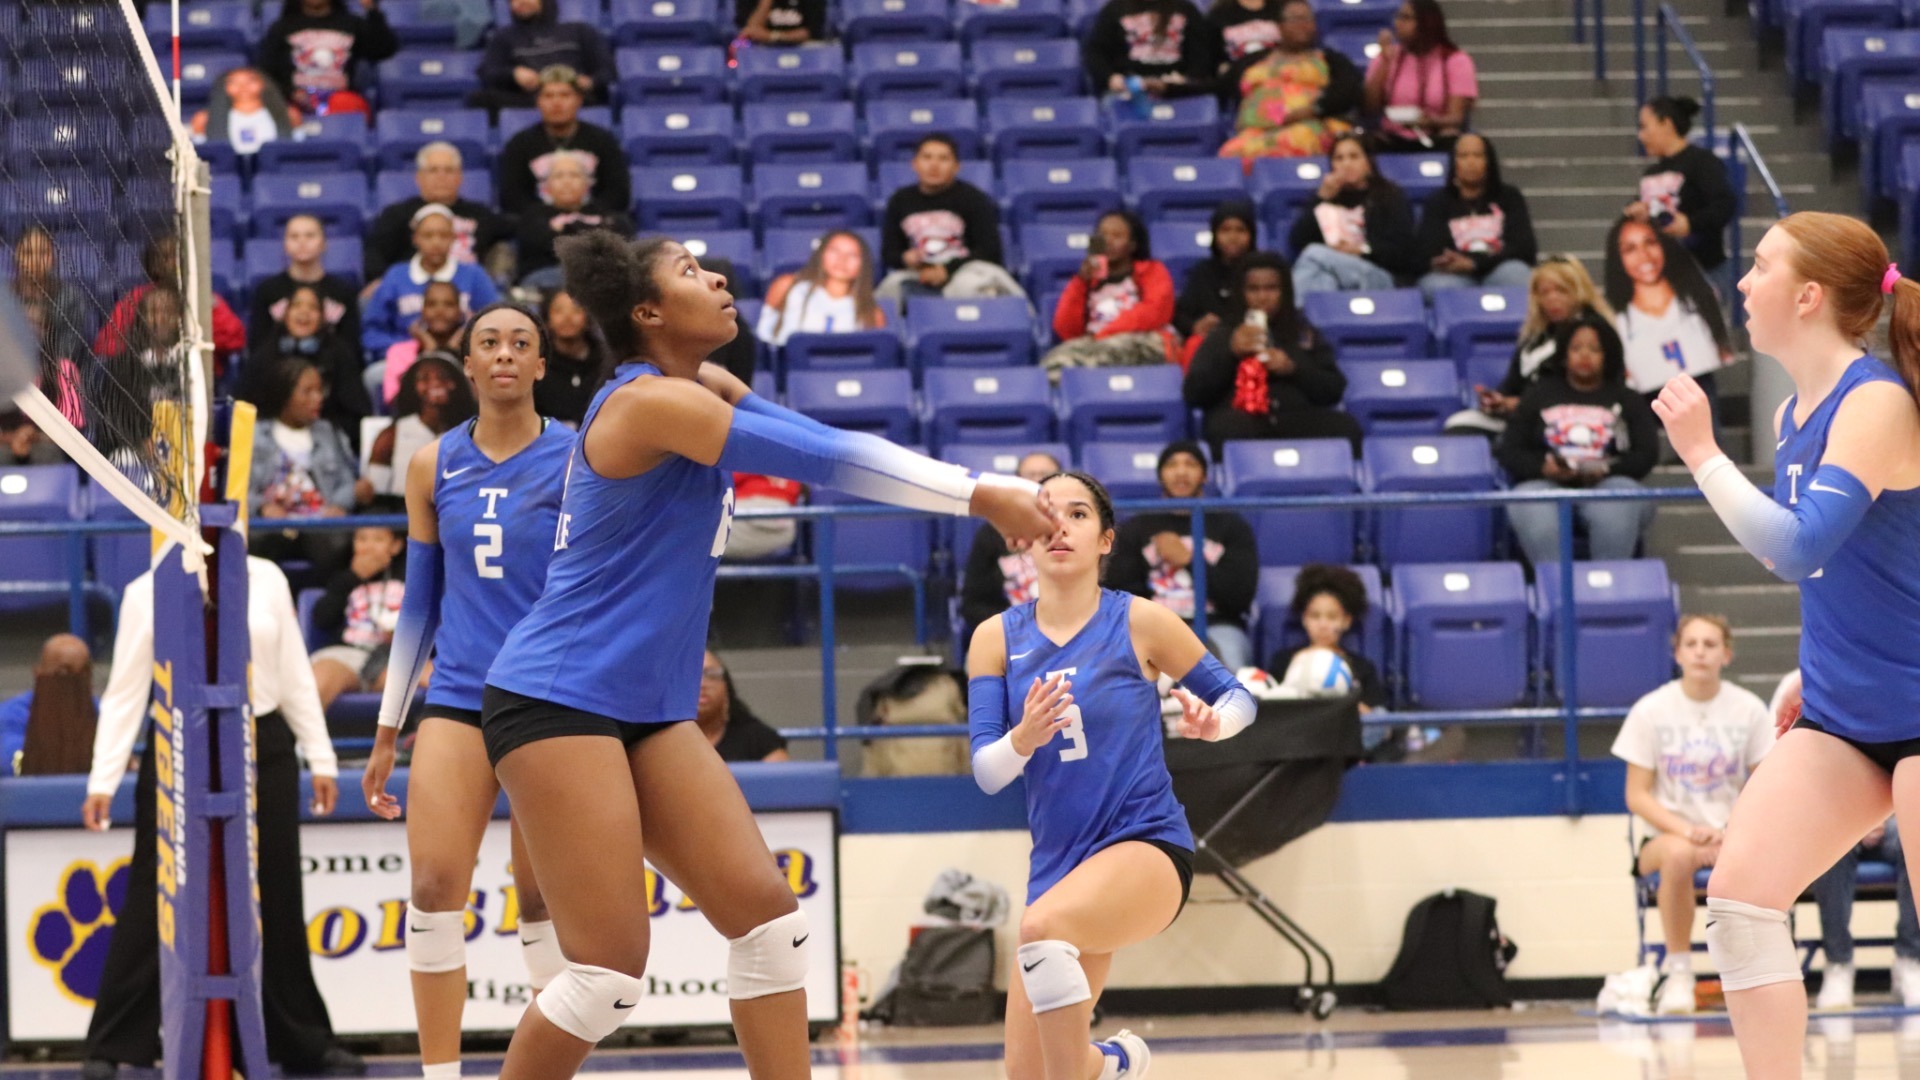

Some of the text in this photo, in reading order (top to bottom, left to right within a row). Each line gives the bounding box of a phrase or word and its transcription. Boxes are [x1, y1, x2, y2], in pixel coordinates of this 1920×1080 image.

[1662, 341, 1686, 370] 4
[479, 488, 508, 519] T
[1787, 464, 1802, 504] T
[474, 523, 503, 579] 2
[1056, 693, 1088, 762] 3
[153, 659, 176, 952] TIGERS
[172, 706, 187, 886] CORSICANA
[300, 853, 402, 874] ome
